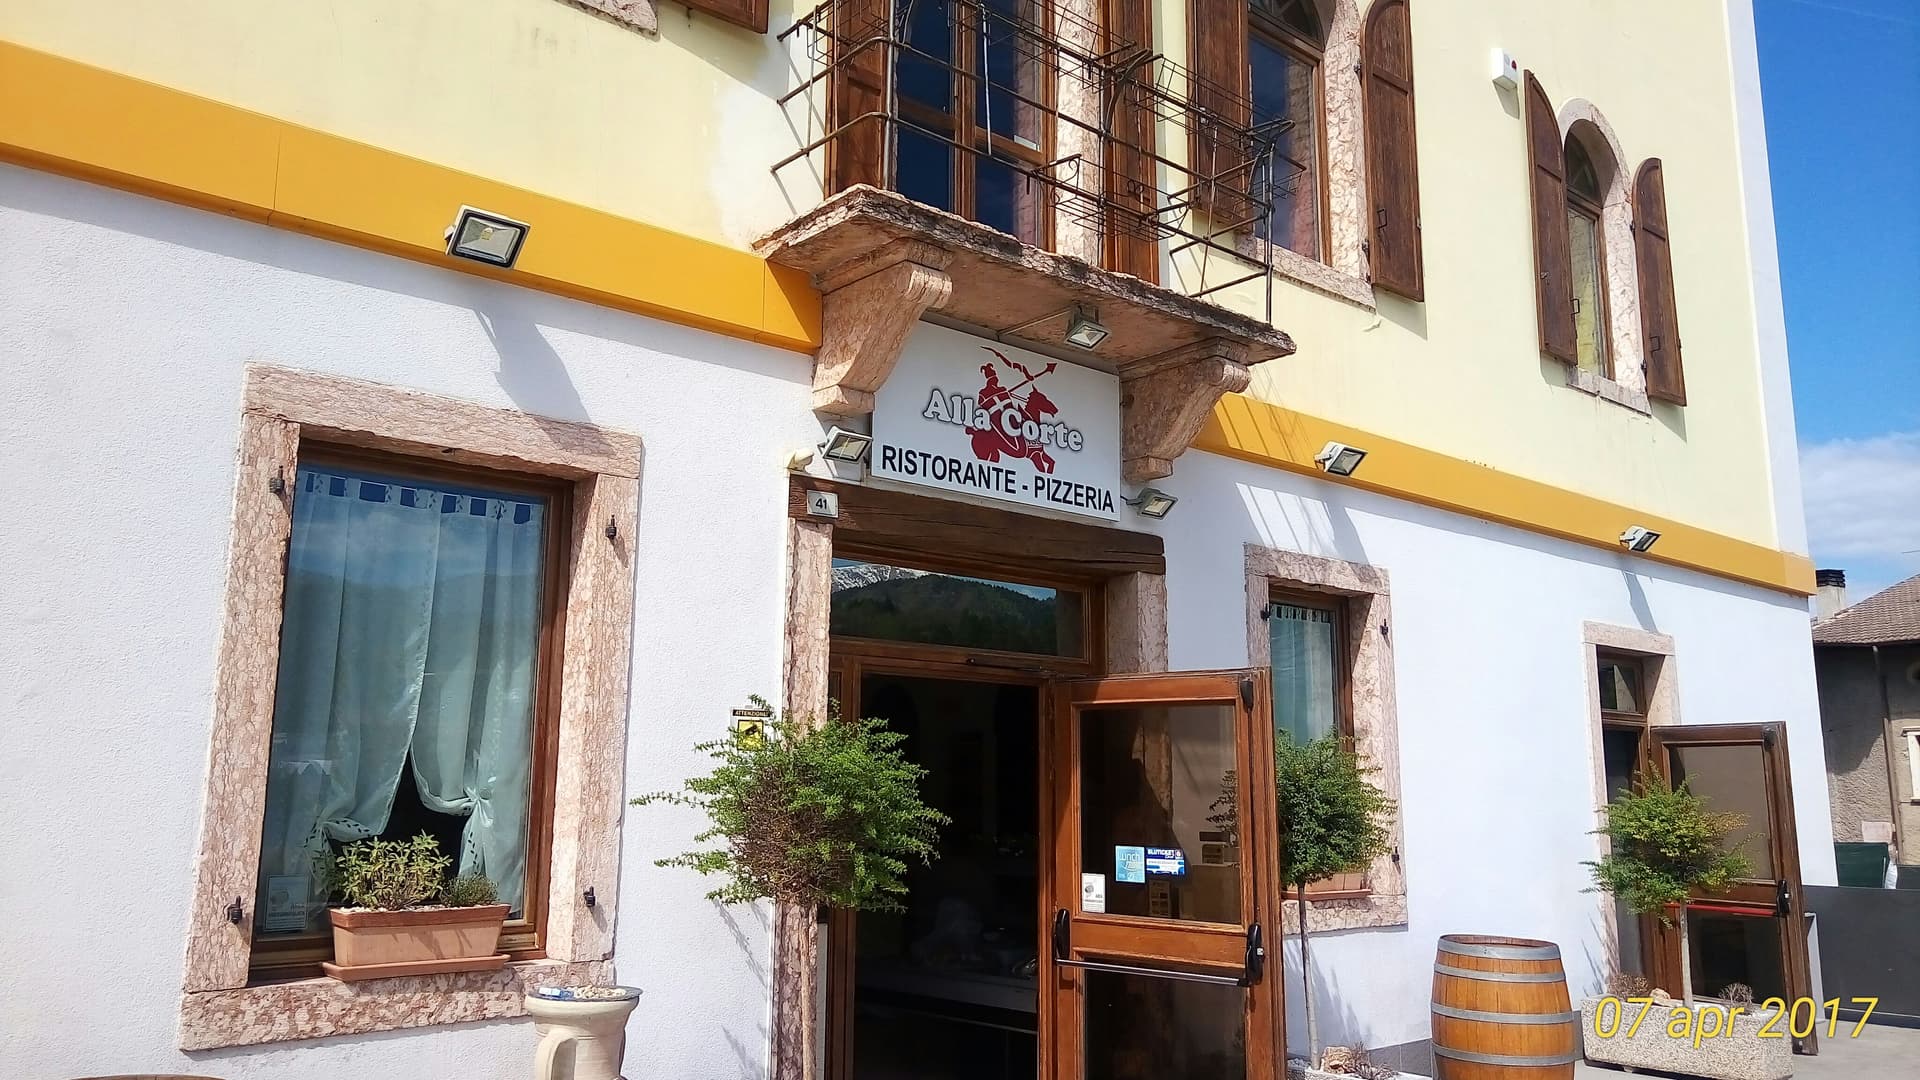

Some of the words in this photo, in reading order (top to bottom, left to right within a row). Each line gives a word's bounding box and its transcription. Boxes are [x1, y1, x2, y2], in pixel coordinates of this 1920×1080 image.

[923, 388, 993, 431] Alla
[1000, 407, 1084, 452] Corte
[815, 498, 828, 510] 41
[882, 445, 1017, 494] RISTORANTE
[1033, 475, 1115, 513] PIZZERIA
